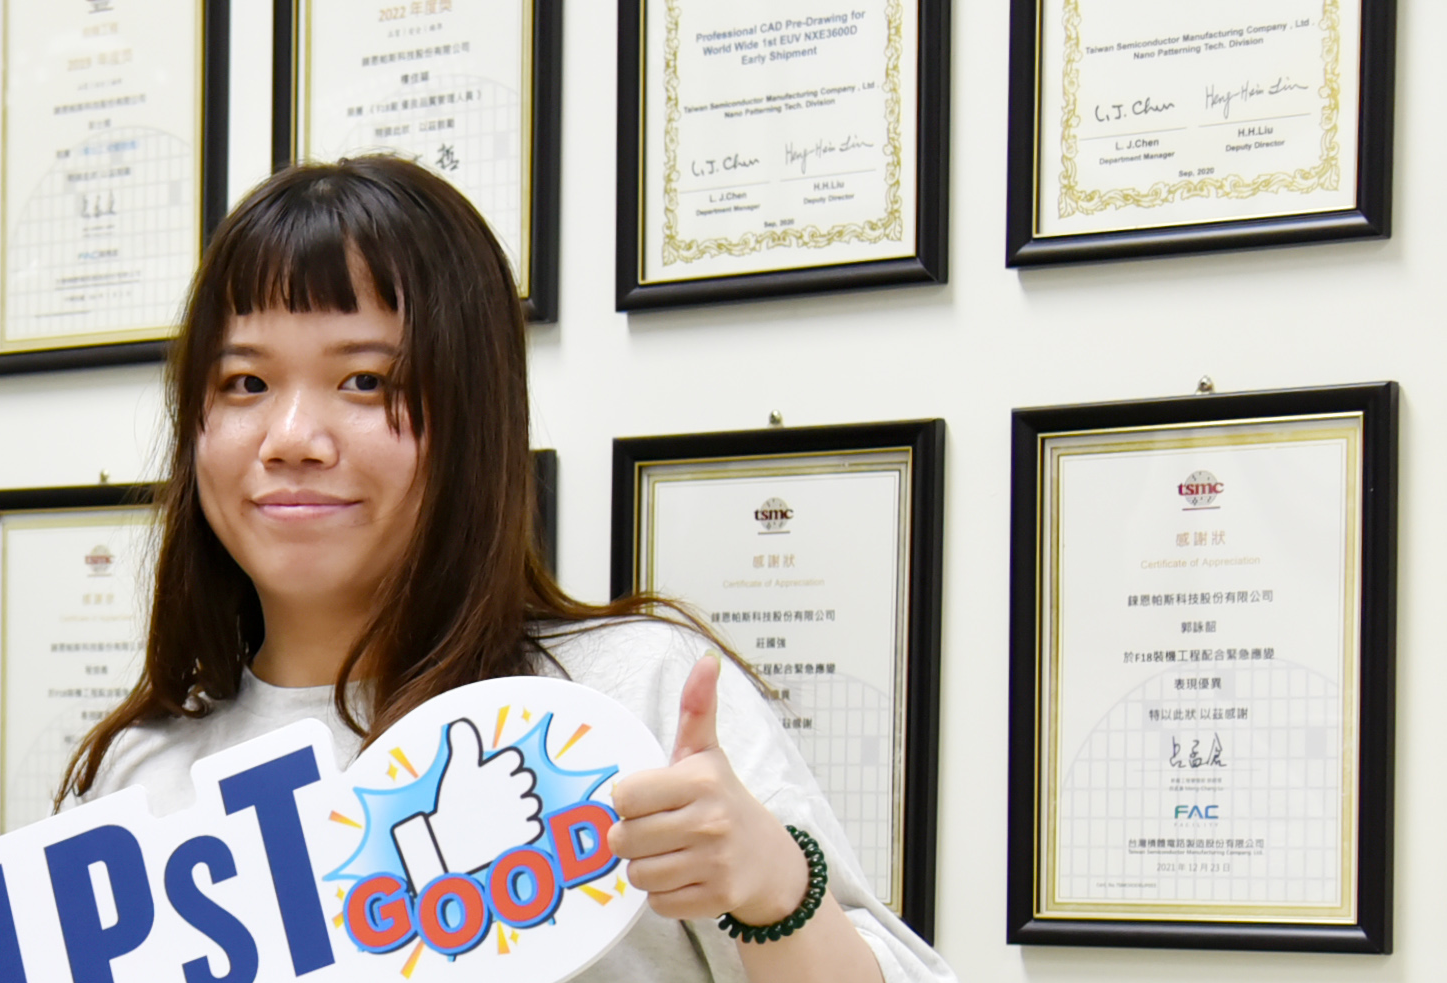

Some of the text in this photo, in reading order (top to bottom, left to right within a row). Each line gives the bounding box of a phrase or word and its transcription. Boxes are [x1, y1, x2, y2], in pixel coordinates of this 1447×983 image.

[378, 5, 407, 22] 2022
[695, 10, 866, 43] Professional CAD Pre-Drawing for
[702, 25, 858, 56] World Wide 1st EUV NXE3600D
[1085, 44, 1115, 55] Taiwan
[1116, 36, 1180, 51] Semiconductor
[1182, 27, 1245, 43] Manufacturing
[1133, 36, 1264, 60] Nano Patterning Tech. Division
[741, 46, 818, 66] Early Shipment
[683, 104, 709, 114] Taiwan
[710, 97, 764, 111] Semiconductor
[766, 90, 818, 103] Manufacturing
[724, 111, 743, 119] Nano
[745, 104, 782, 116] Patterning
[805, 97, 835, 108] Division
[1237, 125, 1274, 138] H.H.Liu
[1225, 138, 1285, 152] Deputy Director
[1099, 150, 1175, 165] Department Manager
[1197, 167, 1215, 176] 2020
[813, 181, 845, 191] H.H.Liu
[828, 193, 855, 202] Director
[1177, 482, 1225, 496] tsmc
[754, 507, 794, 521] tsmc
[1175, 530, 1226, 547] 感謝狀
[752, 554, 795, 569] 感謝狀
[1140, 555, 1261, 570] Certificate of Appreciation
[722, 579, 762, 589] Certificate
[775, 578, 825, 588] Appreciation
[1127, 590, 1274, 607] 錸恩帕斯科技股份有限公司
[1174, 677, 1222, 691] 表現優異
[1149, 707, 1249, 721] 特以此狀 以茲感謝
[1174, 804, 1219, 819] FAC
[1156, 863, 1175, 872] 2021
[343, 799, 622, 955] GOOD
